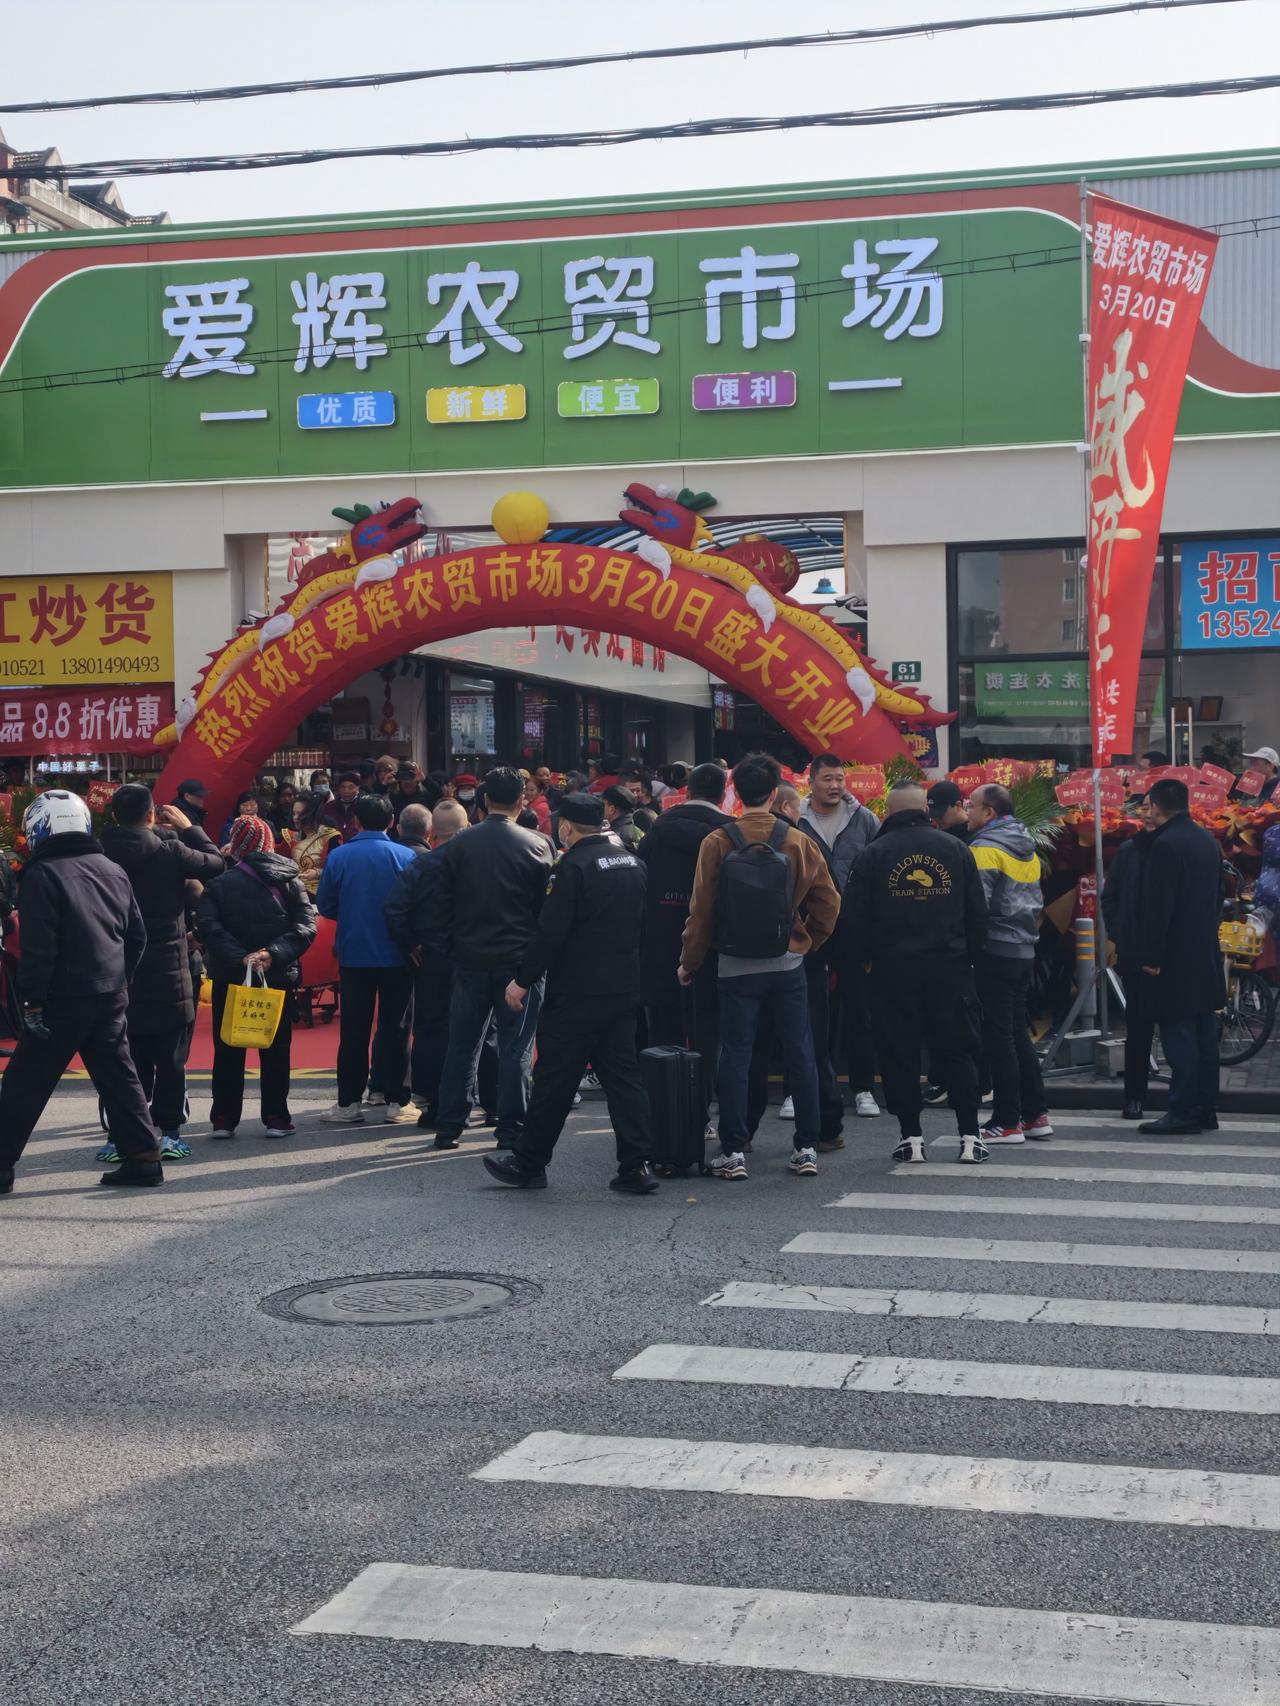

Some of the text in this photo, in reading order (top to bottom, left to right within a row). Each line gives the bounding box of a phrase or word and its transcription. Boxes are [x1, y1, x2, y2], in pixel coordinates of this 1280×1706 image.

[1086, 221, 1209, 295] 爱辉农贸市场
[162, 238, 943, 378] 爱辉农贸市场
[1099, 283, 1176, 328] 3月20日
[446, 389, 509, 418] 新鲜
[578, 383, 641, 414] 便宜
[713, 375, 777, 407] 便利
[316, 395, 377, 424] 优质
[0, 656, 160, 676] 10521 13801490493
[898, 663, 915, 673] 61
[889, 854, 952, 888] YELLOWSTONE
[918, 887, 950, 895] STATION
